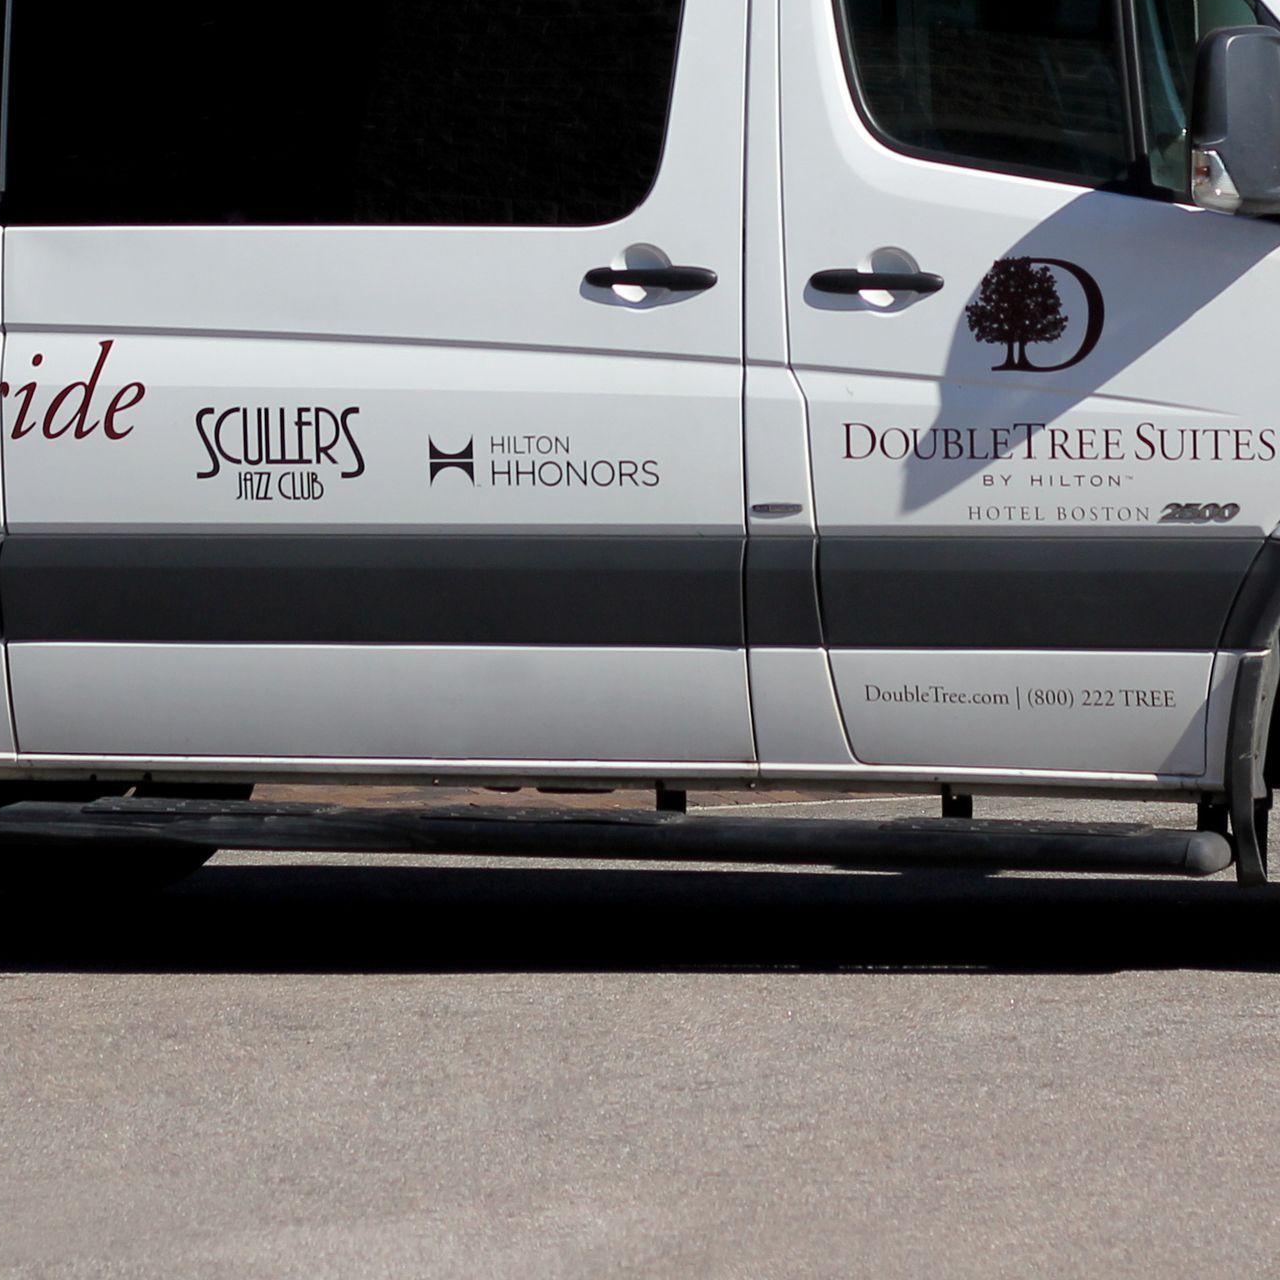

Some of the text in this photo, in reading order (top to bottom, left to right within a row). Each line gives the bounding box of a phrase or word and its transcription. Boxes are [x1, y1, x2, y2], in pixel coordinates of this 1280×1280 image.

[195, 406, 366, 479] SCULLERS
[490, 435, 570, 455] HILTON
[1134, 422, 1276, 462] SUITES
[235, 471, 324, 501] JAZZ CLUB
[490, 459, 661, 488] HHONORS
[982, 474, 1012, 488] BY
[967, 505, 1150, 522] HOTEL BOSTON
[1157, 502, 1239, 524] 2500
[864, 684, 1010, 706] DoubleTree.com
[1027, 688, 1075, 709] (800)
[1081, 689, 1115, 708] 222
[1119, 689, 1177, 708] TREE
